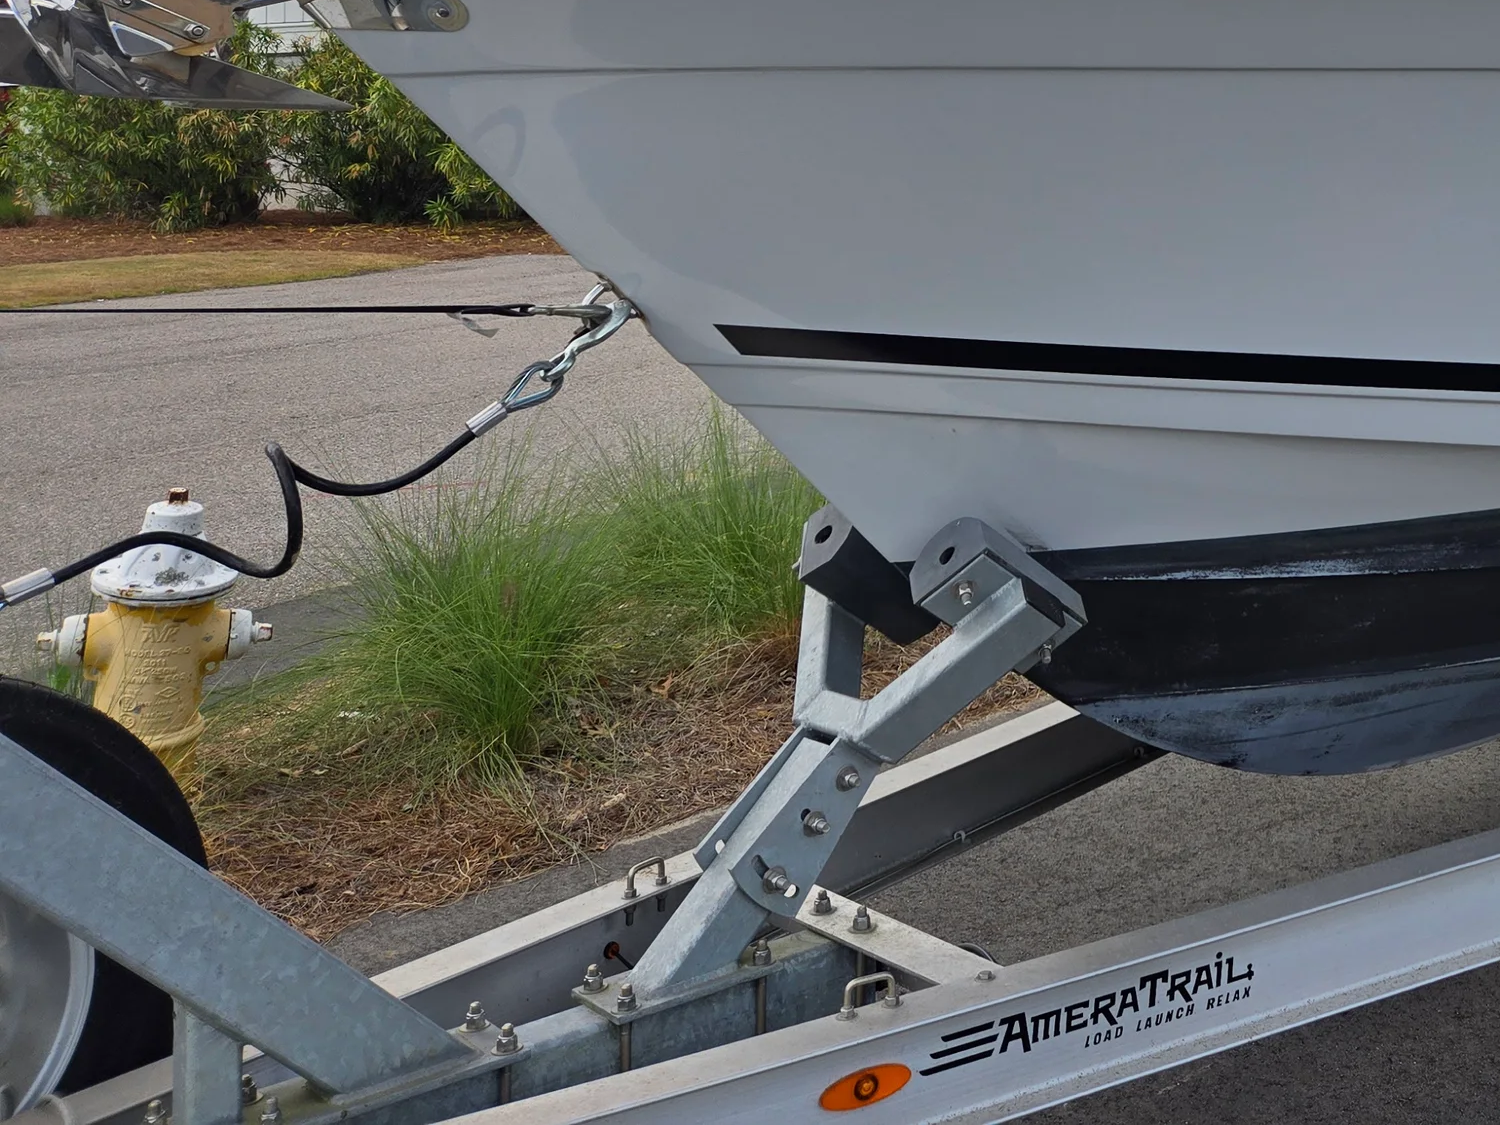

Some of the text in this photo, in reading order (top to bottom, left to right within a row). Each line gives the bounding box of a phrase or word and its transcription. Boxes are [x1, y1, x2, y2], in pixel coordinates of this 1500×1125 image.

[1084, 985, 1253, 1049] LOAD LAUNCH RELAX
